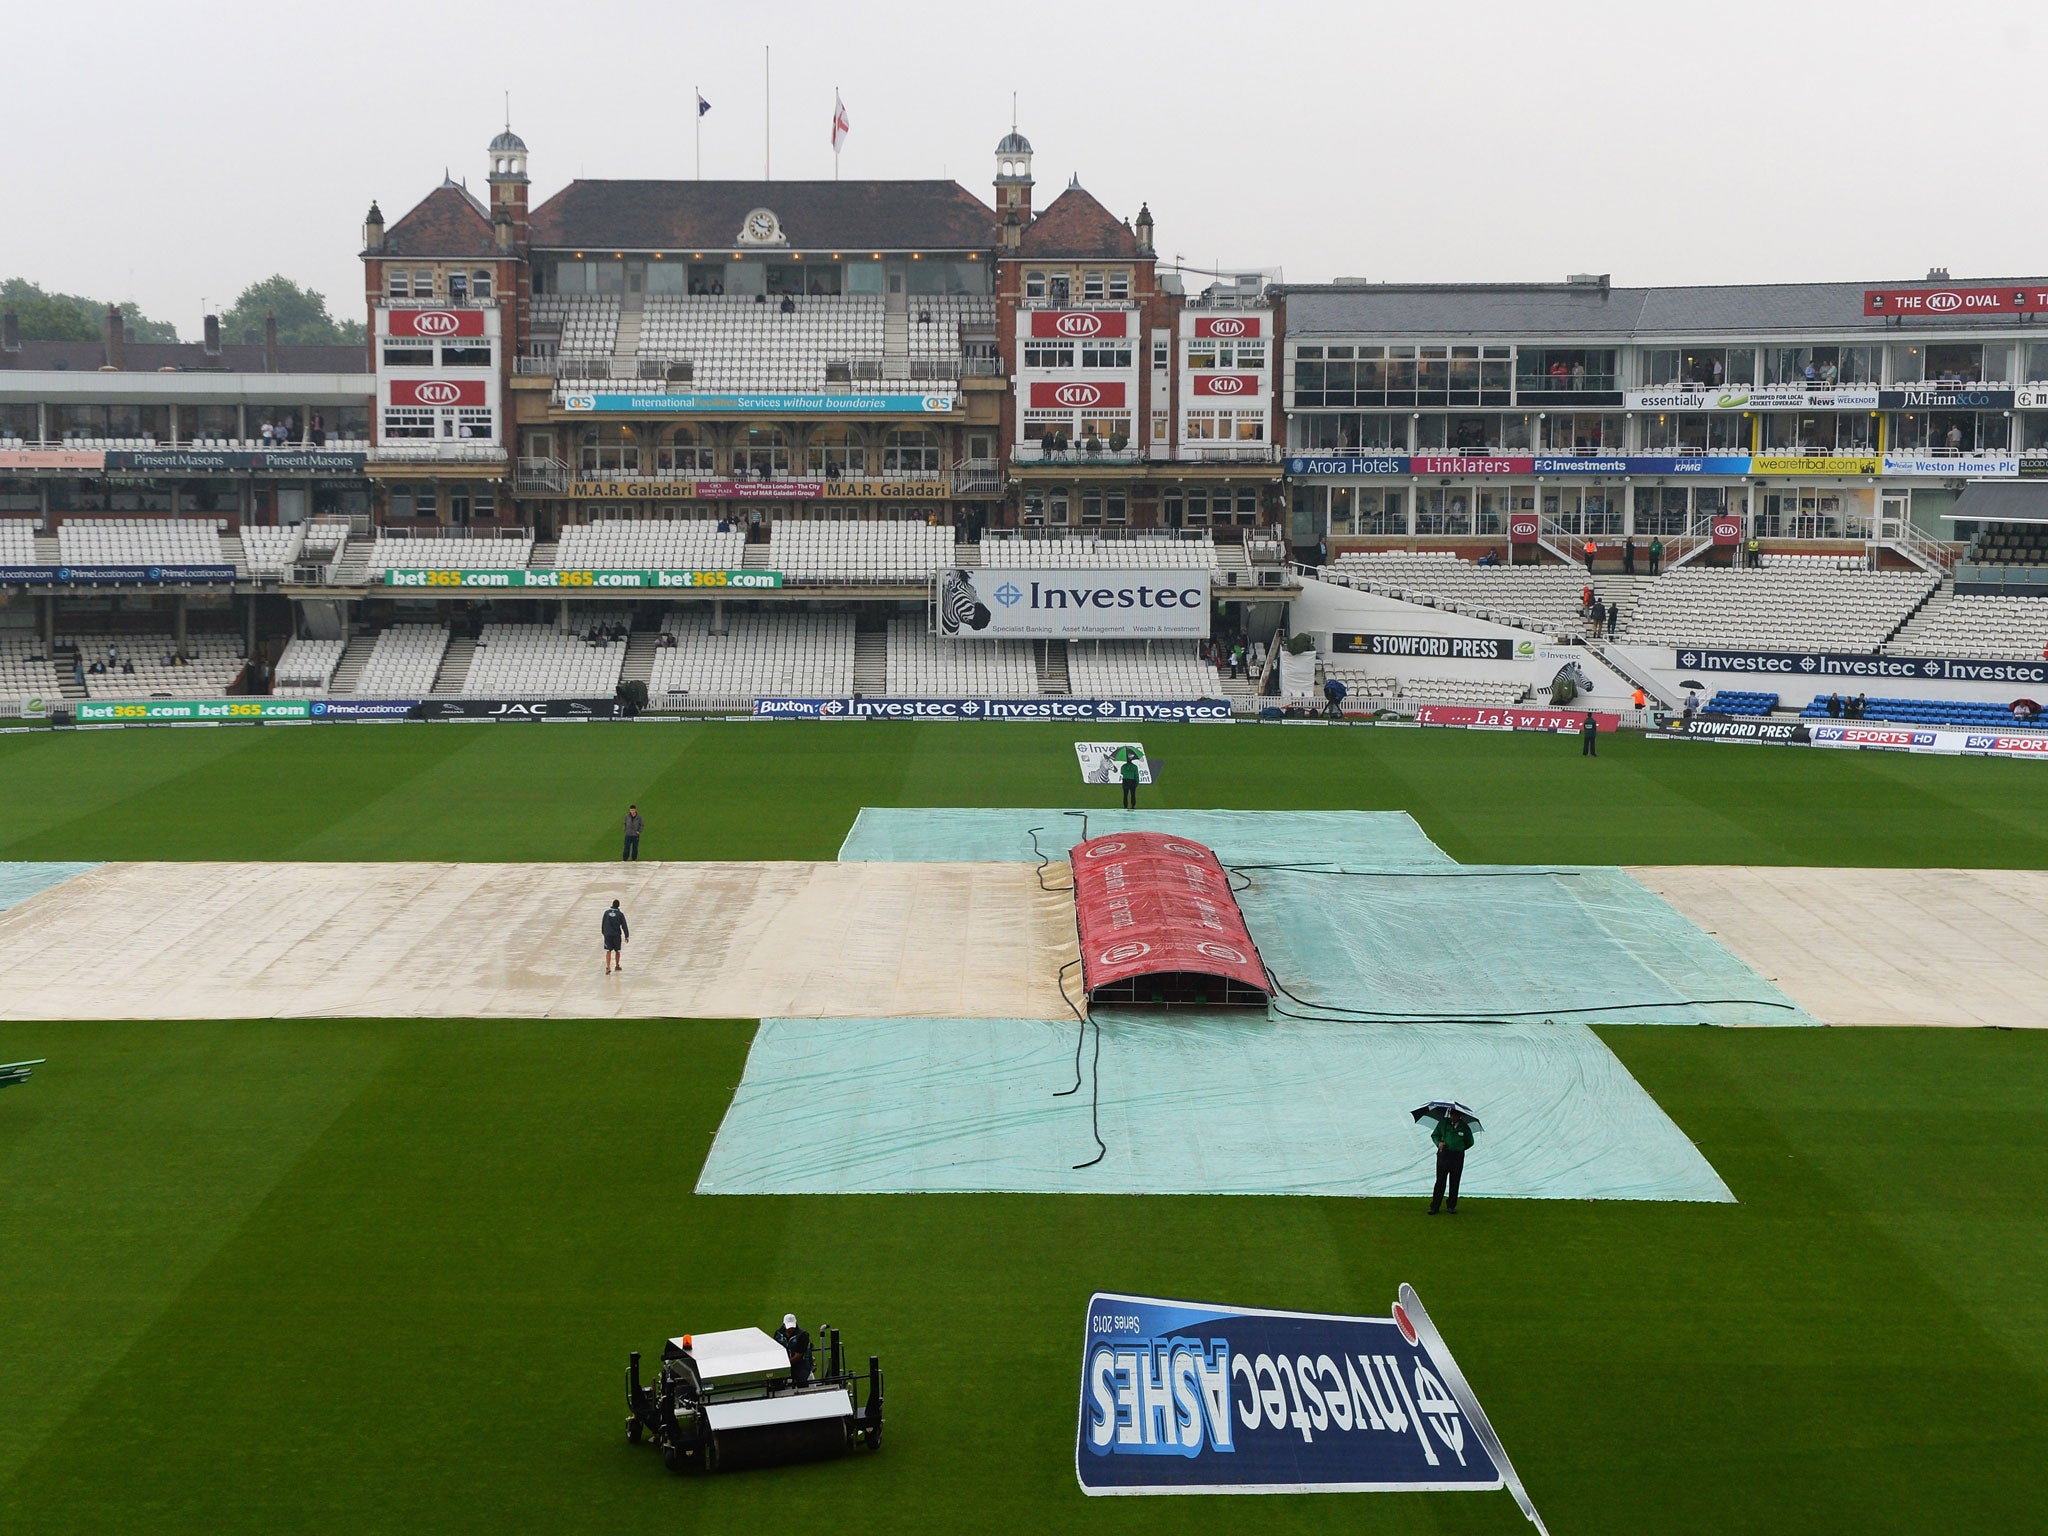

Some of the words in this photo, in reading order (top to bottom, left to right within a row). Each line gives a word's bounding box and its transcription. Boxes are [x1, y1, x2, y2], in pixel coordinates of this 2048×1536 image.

[1895, 296, 1921, 308] THE
[1932, 296, 1956, 308] KIA
[1965, 295, 2000, 307] OVAL
[421, 316, 452, 330] KIA
[1064, 318, 1095, 331] KIA
[1216, 322, 1239, 332] KIA
[1214, 380, 1237, 391] KIA
[422, 386, 453, 400] KIA
[1063, 388, 1094, 401] KIA
[1902, 391, 1989, 408] JMFinn&Co
[631, 398, 695, 408] International
[738, 398, 781, 408] Services
[783, 398, 824, 408] without
[826, 398, 886, 408] boundaries
[1641, 394, 1705, 409] essentially
[1808, 396, 1835, 406] News
[134, 454, 177, 466] Pinsent
[178, 455, 224, 466] Masons
[266, 454, 307, 466] Pinsent
[309, 455, 353, 466] Masons
[1307, 460, 1347, 474] Arora
[1352, 458, 1399, 473] Hotels
[1427, 459, 1511, 473] Linklaters
[1553, 460, 1626, 471] Investments
[1674, 463, 1701, 471] KPMG
[1759, 459, 1858, 470] wearetribal.com
[1916, 461, 1955, 472] Weston
[1958, 461, 1996, 472] Homes
[1999, 461, 2016, 472] Plc
[2020, 460, 2045, 468] BLOOD
[574, 484, 623, 497] M.A.R.
[627, 483, 692, 497] Galadari
[827, 483, 877, 496] M.A.R.
[880, 483, 946, 497] Galadari
[1516, 525, 1532, 533] KIA
[1718, 526, 1734, 534] KIA
[71, 569, 145, 579] PrimeLocation.com
[161, 569, 234, 578] PrimeLocation.com
[392, 571, 509, 586] bet365.com
[524, 571, 641, 586] bet365.com
[658, 572, 774, 587] bet365.com
[1030, 581, 1202, 609] Investec
[992, 625, 1024, 633] Specialist
[1026, 626, 1053, 634] Banking
[1061, 625, 1080, 633] Asset
[1081, 625, 1125, 633] Management
[1132, 625, 1156, 633] Wealth
[1157, 625, 1162, 633] &
[1163, 625, 1200, 633] Investment
[1372, 635, 1449, 656] STOWFORD
[1452, 639, 1498, 659] PRESS
[1547, 652, 1581, 661] Investec
[1700, 655, 1793, 672] Investec
[1819, 659, 1915, 677] Investec
[1944, 664, 2044, 682] Investec
[82, 704, 191, 718] bet365.com
[198, 703, 305, 716] bet365.com
[760, 701, 813, 714] Buxton
[848, 700, 957, 716] Investec
[984, 700, 1093, 717] Investec
[1120, 701, 1227, 718] Investec
[1688, 721, 1756, 737] STOWFORD
[1818, 728, 1843, 741] sky
[1846, 730, 1909, 744] SPORTS
[1914, 735, 1933, 744] HD
[1970, 736, 1995, 749] sky
[1093, 1314, 1112, 1333] 2013
[1114, 1315, 1140, 1334] Series
[1091, 1350, 1231, 1448] ASHES
[1232, 1352, 1440, 1466] Investec
